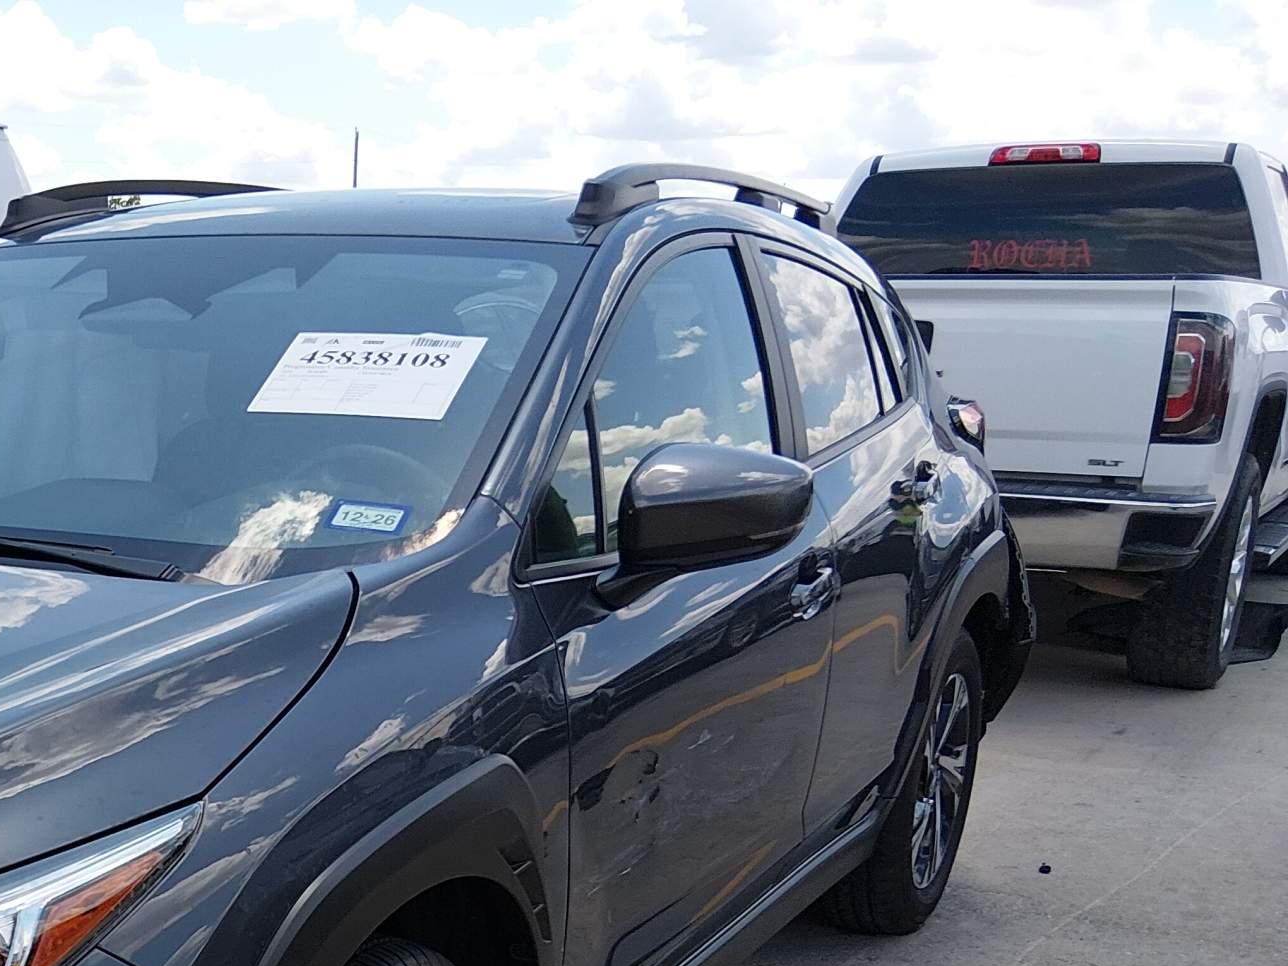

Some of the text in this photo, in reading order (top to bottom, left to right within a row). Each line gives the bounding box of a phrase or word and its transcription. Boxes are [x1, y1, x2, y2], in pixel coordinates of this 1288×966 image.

[968, 238, 1091, 269] ROCHA
[299, 349, 451, 368] 45838108
[1087, 458, 1125, 467] SLT
